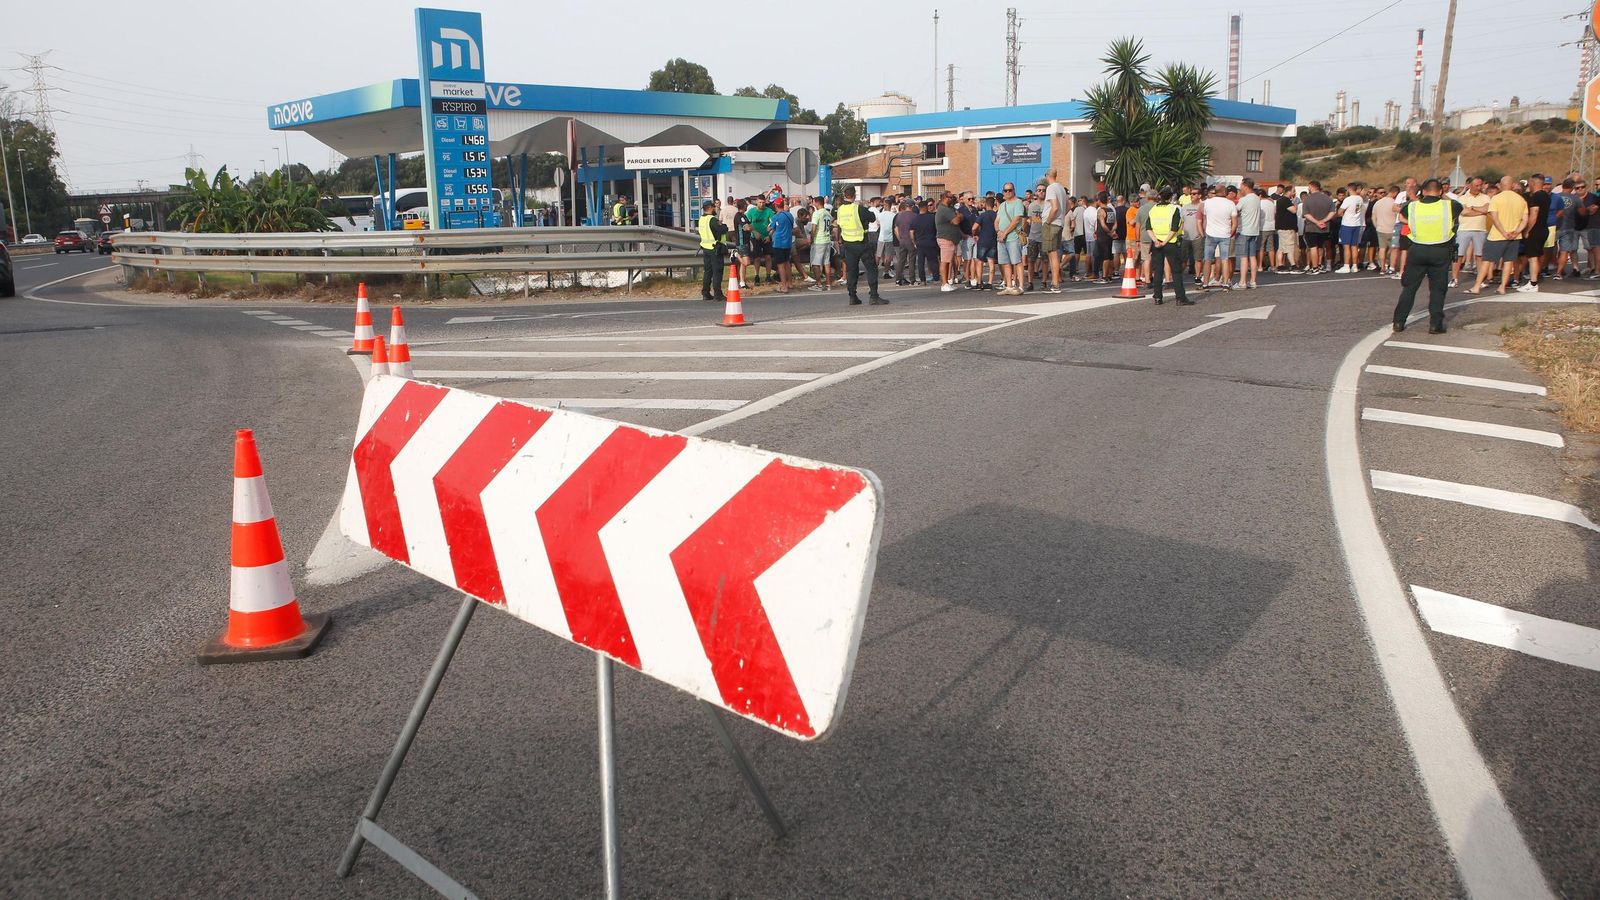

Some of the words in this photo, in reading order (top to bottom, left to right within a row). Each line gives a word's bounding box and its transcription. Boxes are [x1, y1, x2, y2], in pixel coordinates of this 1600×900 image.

[443, 88, 474, 96] market
[274, 100, 314, 125] moeve
[823, 218, 831, 232] 19
